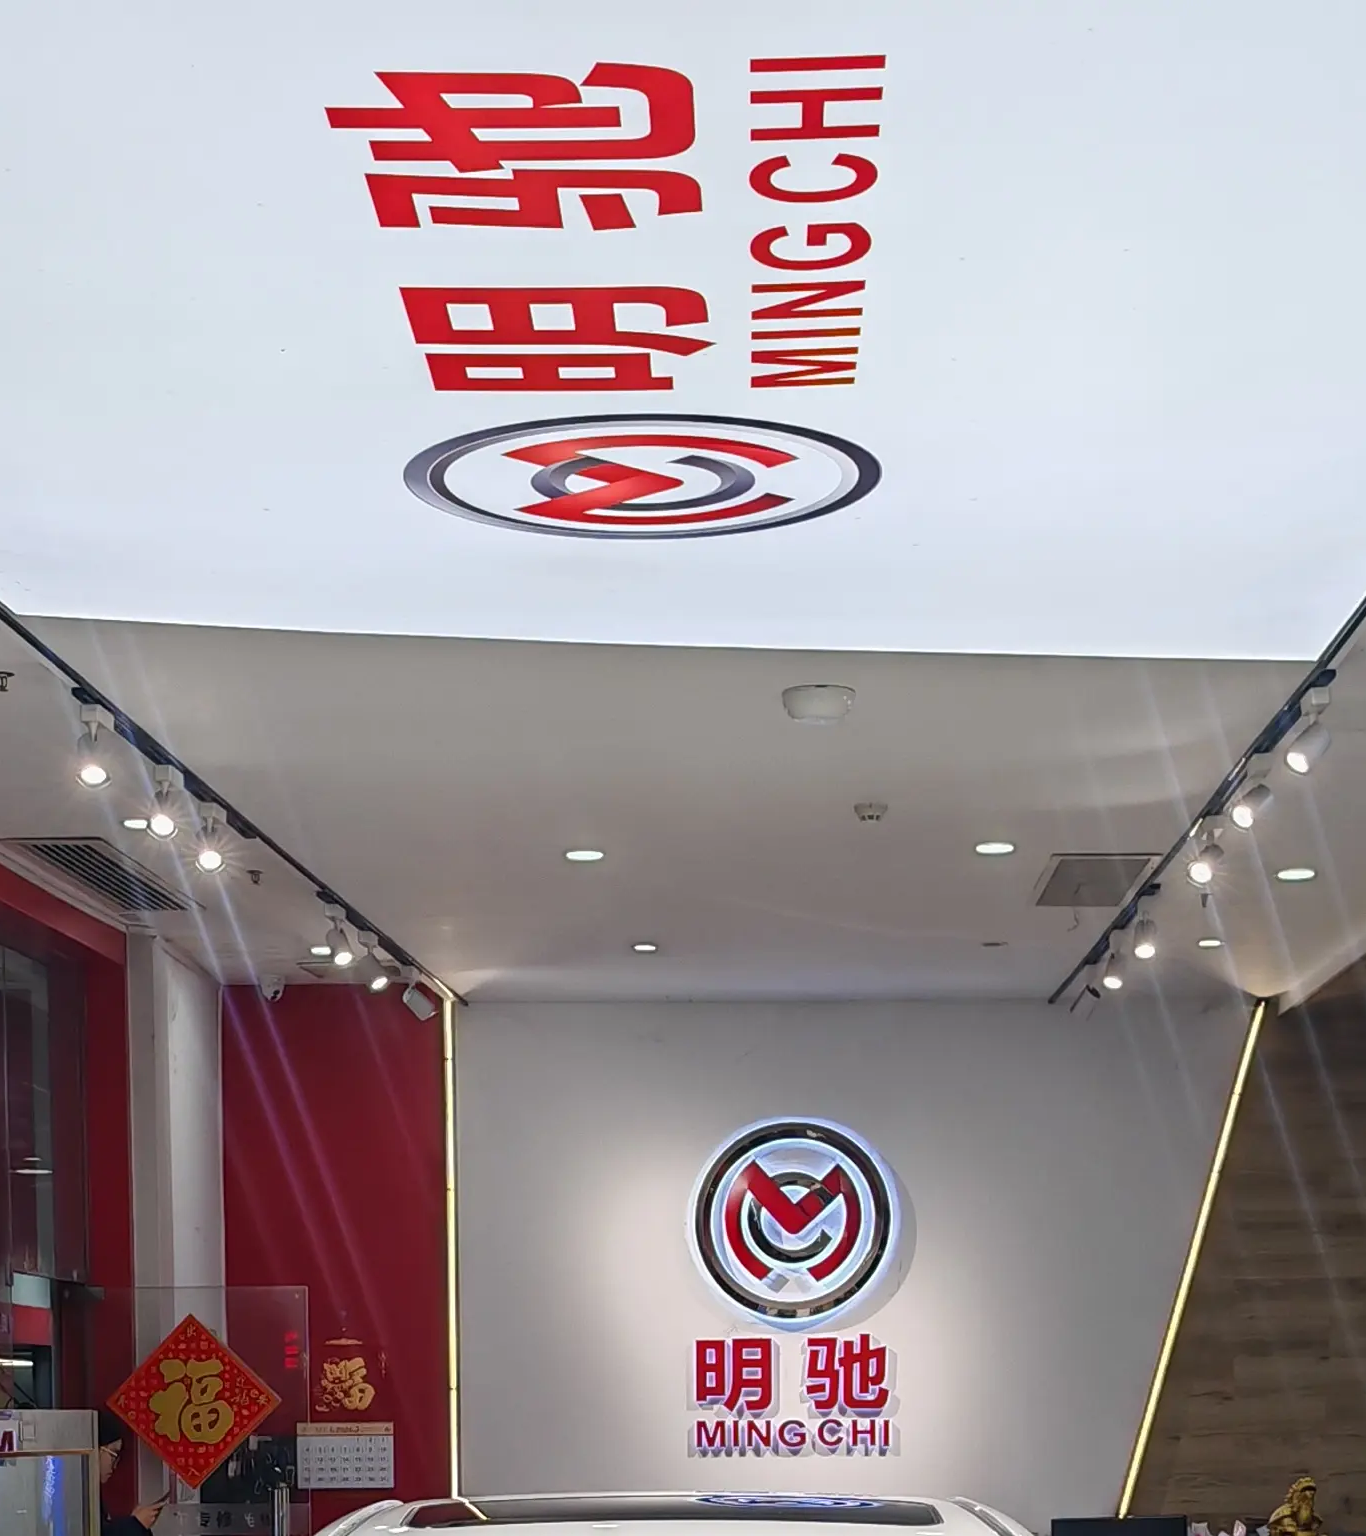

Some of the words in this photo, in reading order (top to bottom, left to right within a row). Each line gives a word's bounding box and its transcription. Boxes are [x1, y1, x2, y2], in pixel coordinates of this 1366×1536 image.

[324, 61, 717, 392] 明驰
[148, 1358, 235, 1445] 福
[695, 1333, 891, 1412] 明驰
